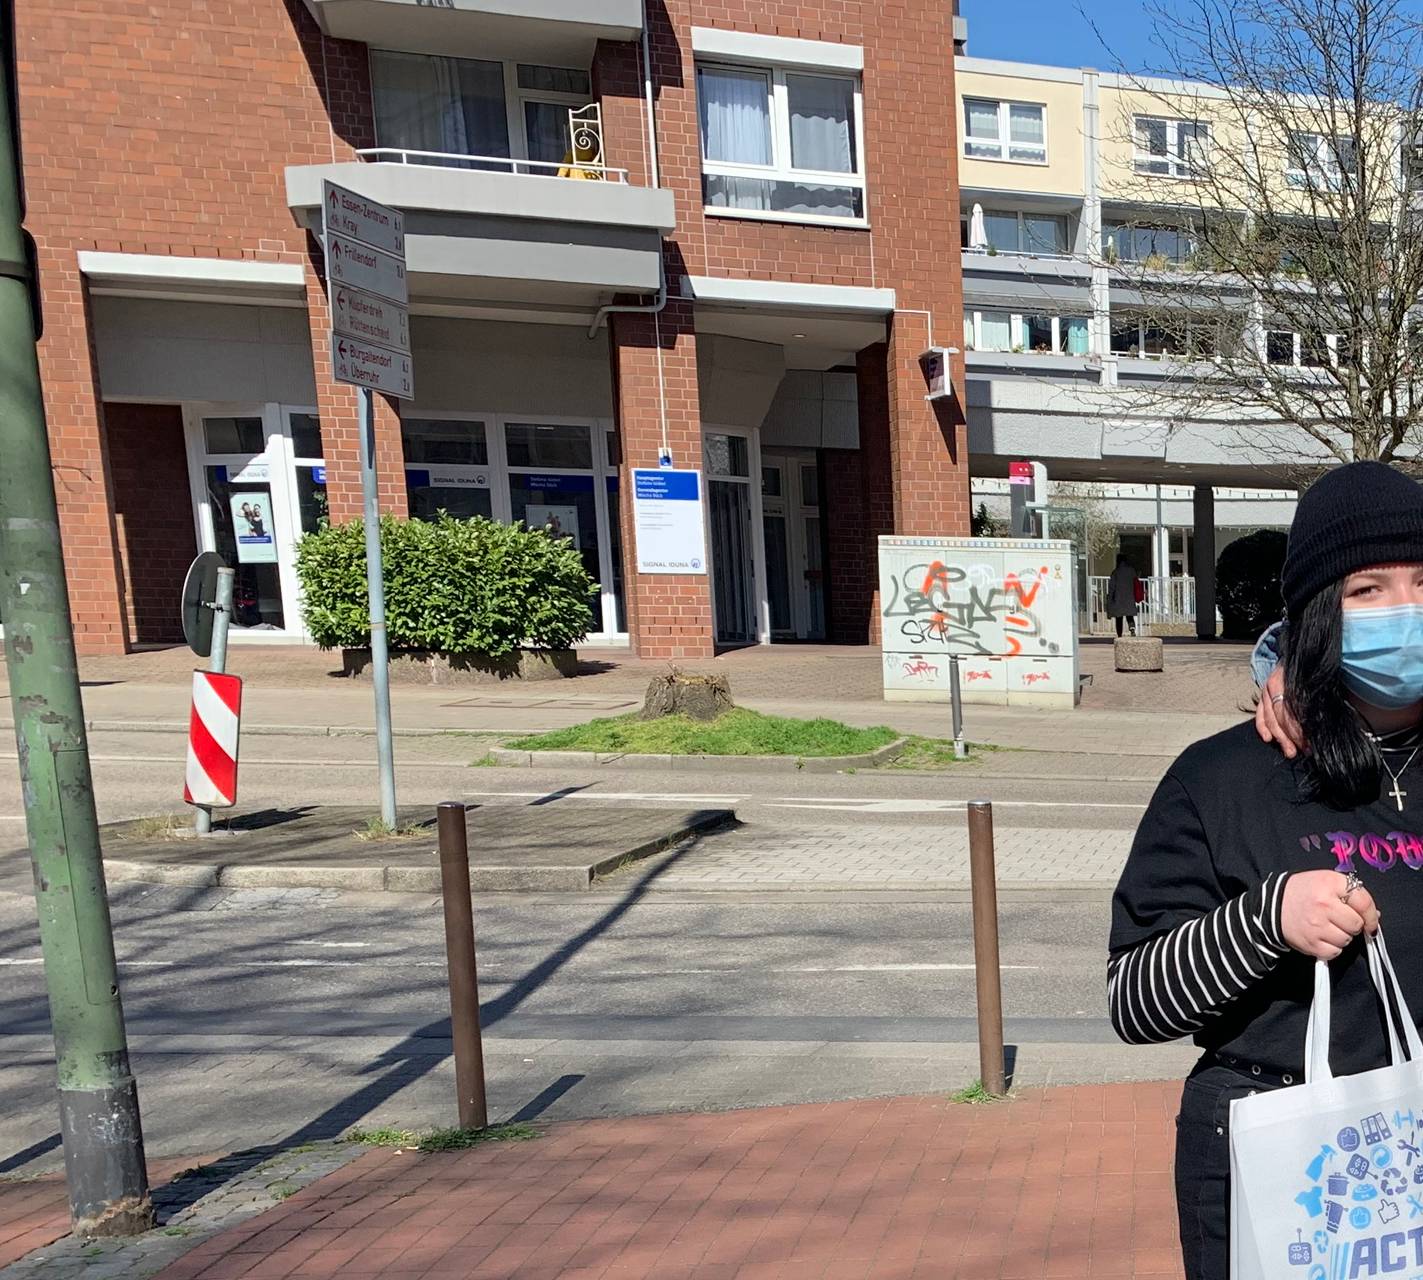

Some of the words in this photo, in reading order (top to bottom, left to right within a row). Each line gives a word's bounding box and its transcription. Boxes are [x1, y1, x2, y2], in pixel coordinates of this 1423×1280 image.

[342, 195, 390, 225] Essen-Zentrum
[343, 215, 358, 236] Kray
[344, 245, 377, 269] Frillendorf
